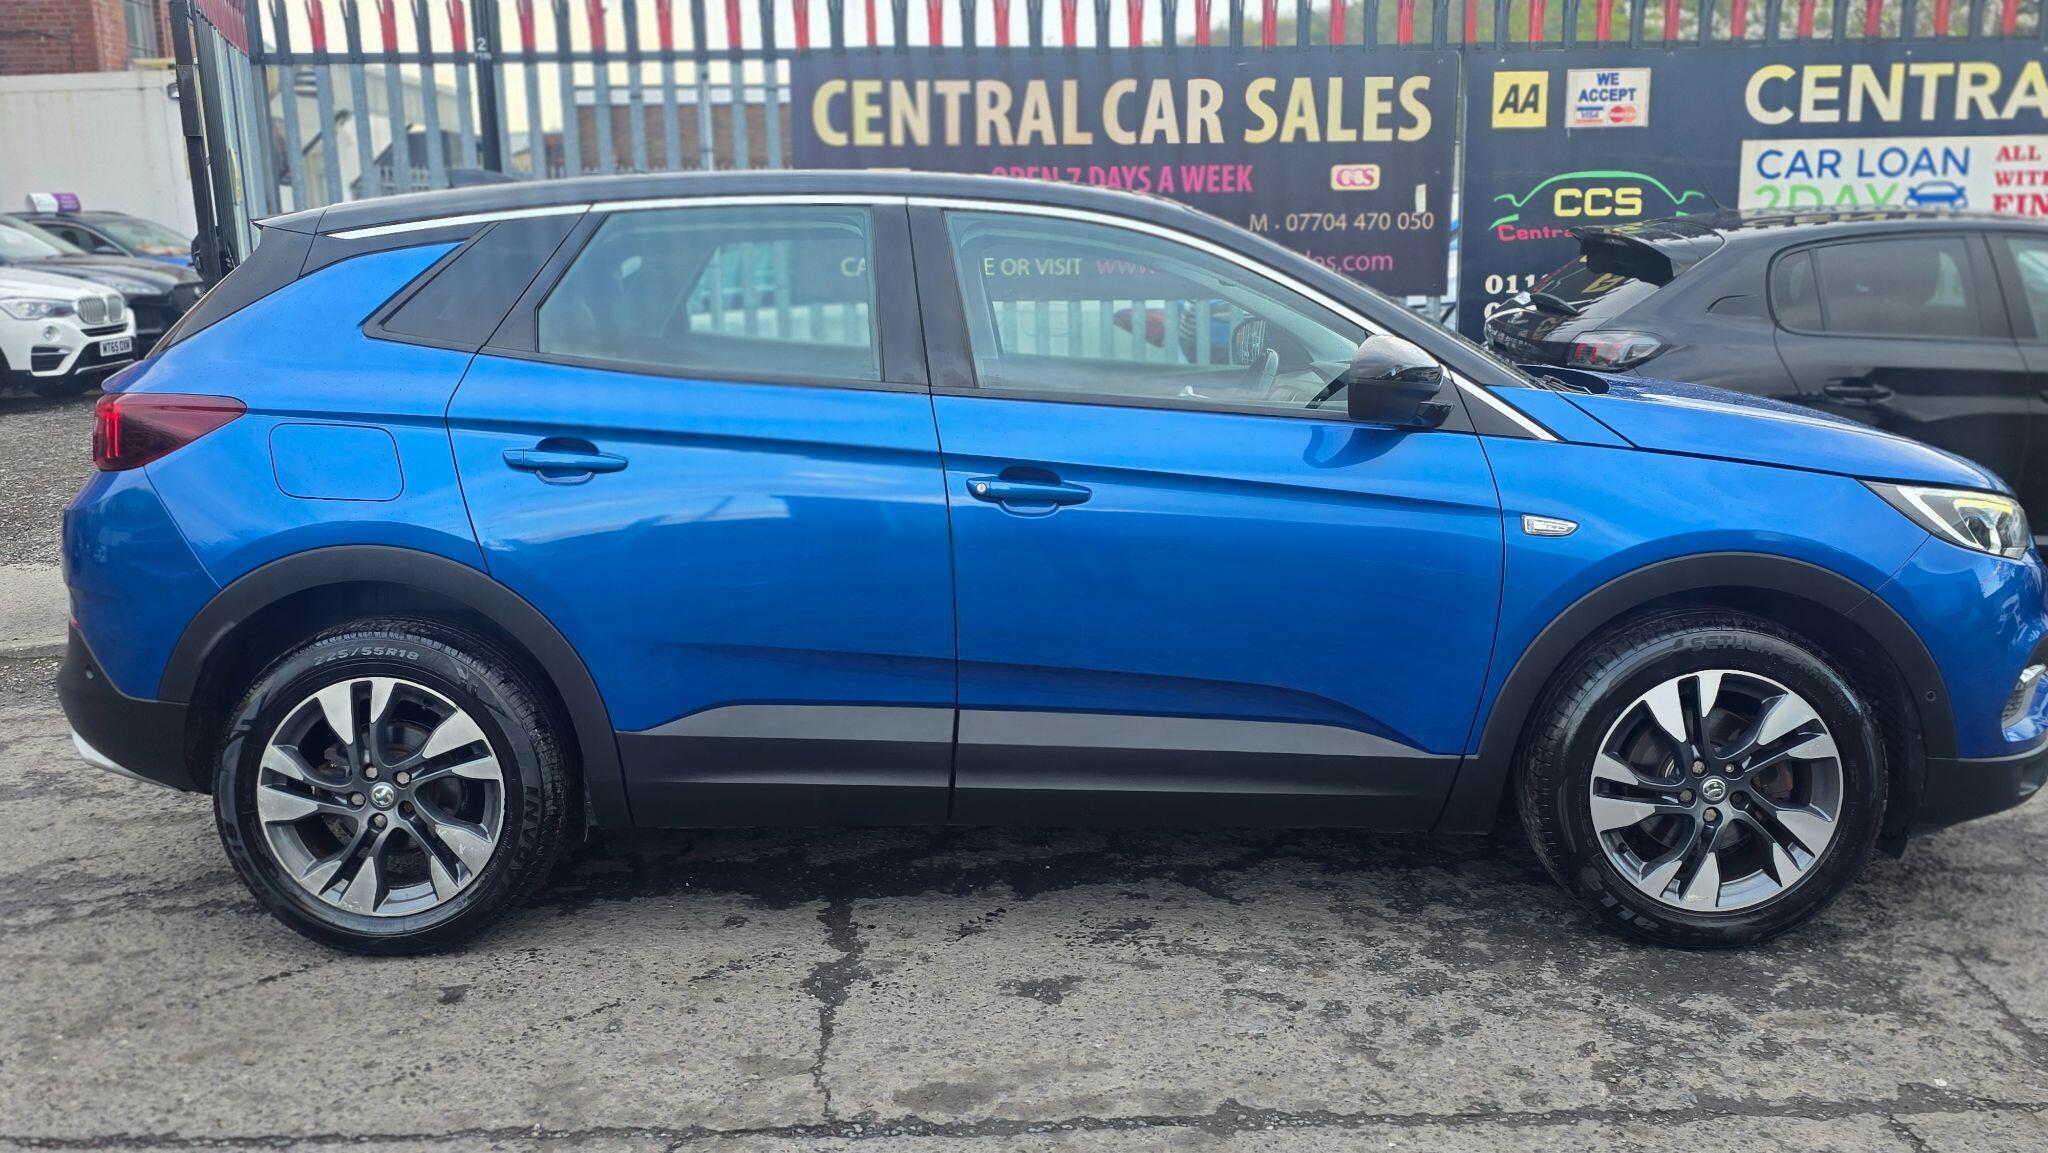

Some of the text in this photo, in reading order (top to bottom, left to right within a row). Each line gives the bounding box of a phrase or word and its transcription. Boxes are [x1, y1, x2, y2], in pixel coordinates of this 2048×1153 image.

[1597, 73, 1620, 86] WE
[1498, 84, 1540, 114] AA
[1578, 88, 1636, 103] ACCEPT
[1744, 61, 2048, 125] CENTRA
[812, 76, 1432, 146] CENTRAL CAR SALES
[1756, 147, 1971, 180] CAR LOAN
[1995, 145, 2041, 162] ALL
[1089, 165, 1152, 193] DAYS
[1157, 165, 1175, 193] A
[1181, 164, 1253, 193] WEEK
[1553, 187, 1643, 218] CCS
[1251, 212, 1435, 231] M 07704 470 050
[1001, 257, 1030, 276] OR
[1035, 257, 1082, 276] VISIT
[314, 646, 420, 666] 225/55R18
